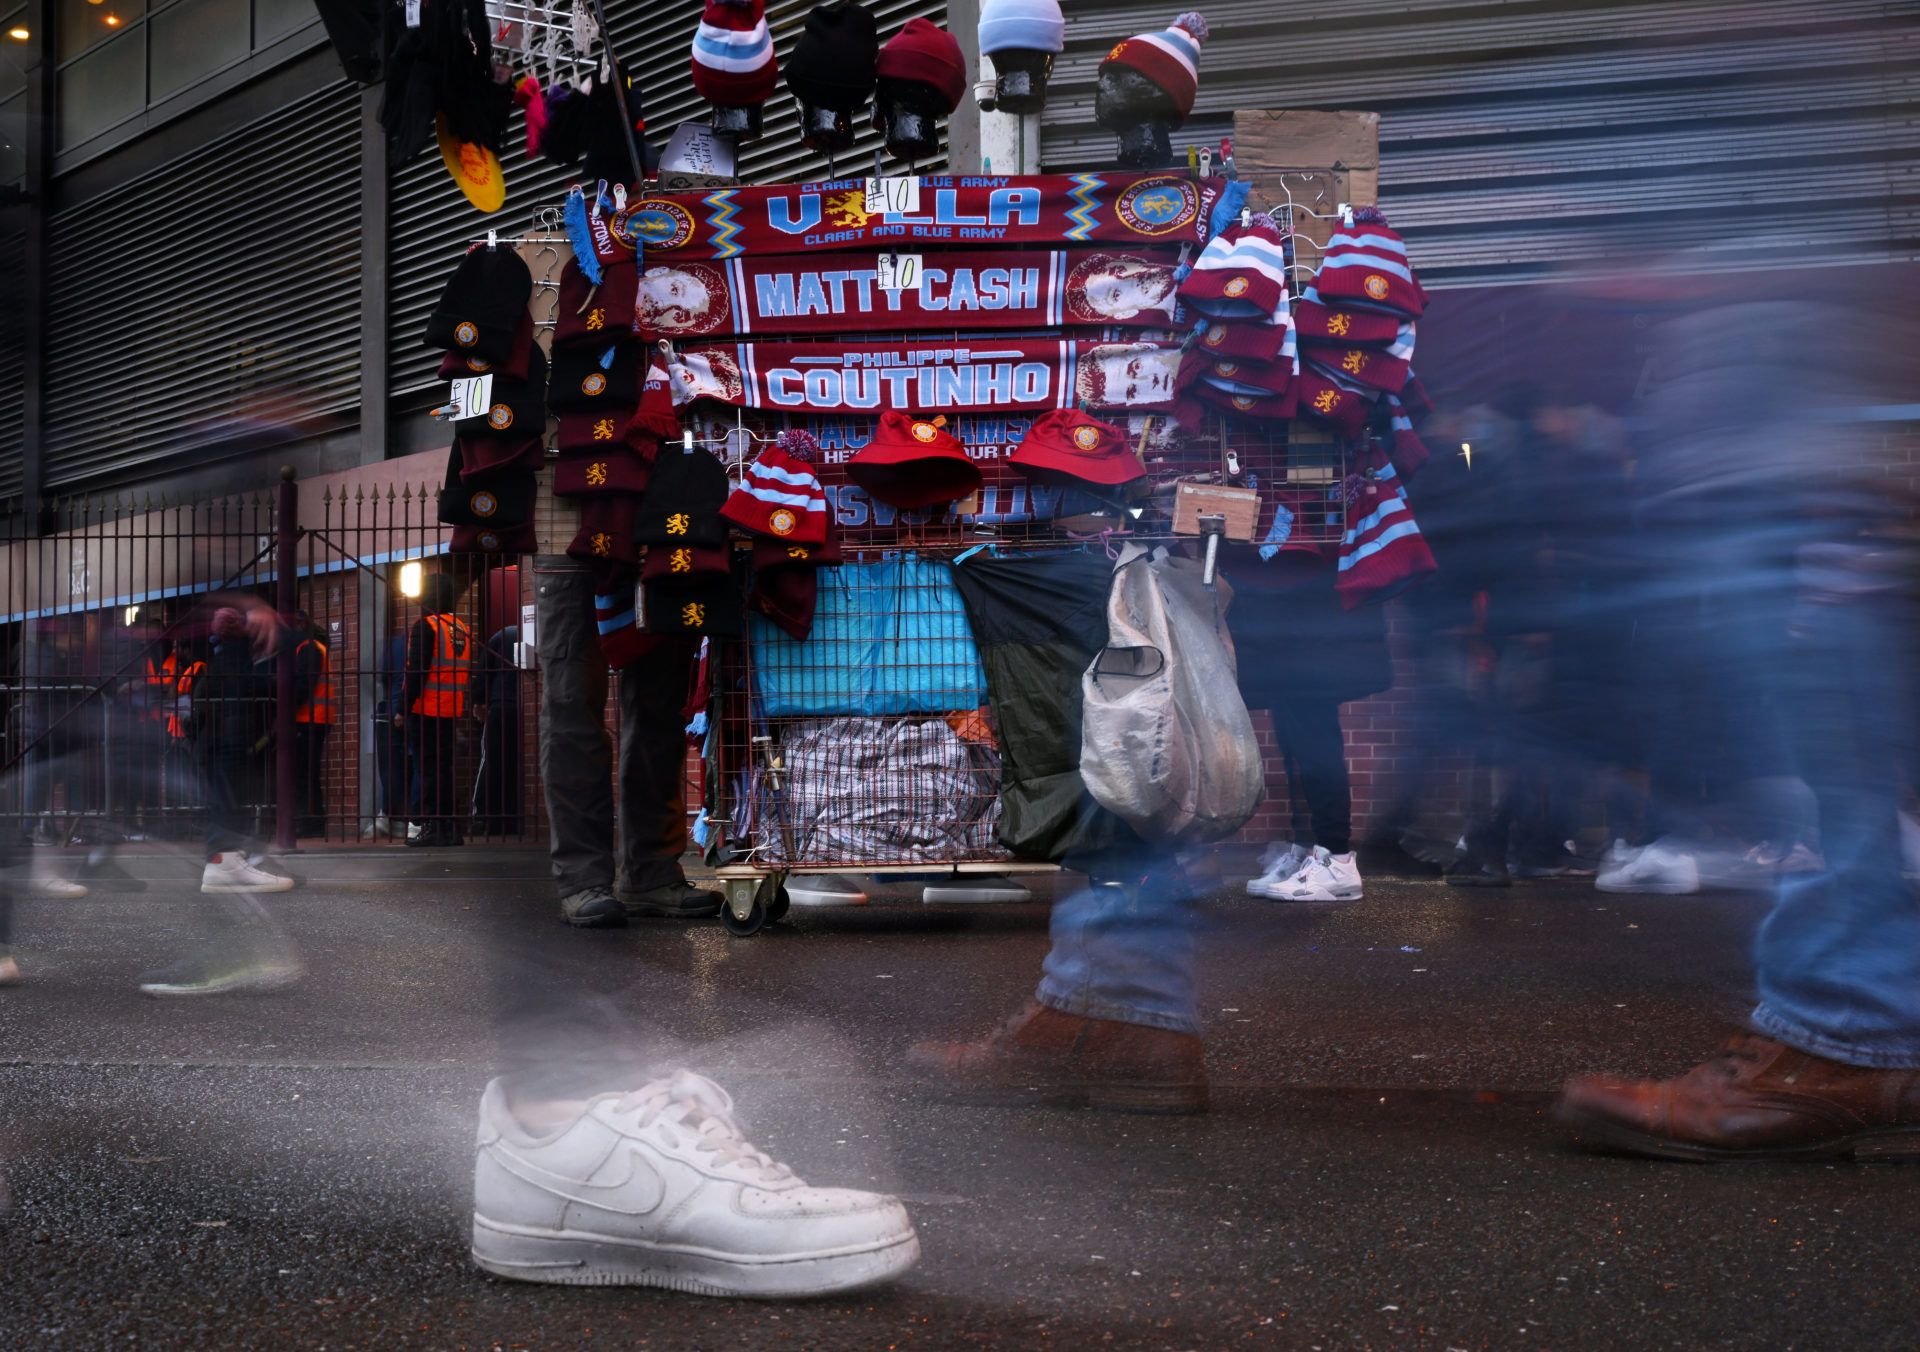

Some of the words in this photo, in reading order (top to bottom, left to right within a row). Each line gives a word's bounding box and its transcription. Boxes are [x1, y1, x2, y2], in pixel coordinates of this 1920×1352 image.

[802, 179, 863, 193] CLARET
[919, 177, 954, 188] BLUE
[961, 177, 1010, 188] ARMY
[868, 178, 909, 211] £10
[804, 229, 868, 245] CLARET
[872, 225, 905, 237] AND
[913, 226, 953, 238] BLUE
[960, 226, 1007, 239] ARMY
[878, 257, 914, 288] £10
[919, 268, 1040, 311] CASH
[843, 349, 972, 368] PHILIPPE
[766, 362, 1051, 409] COUTINHO
